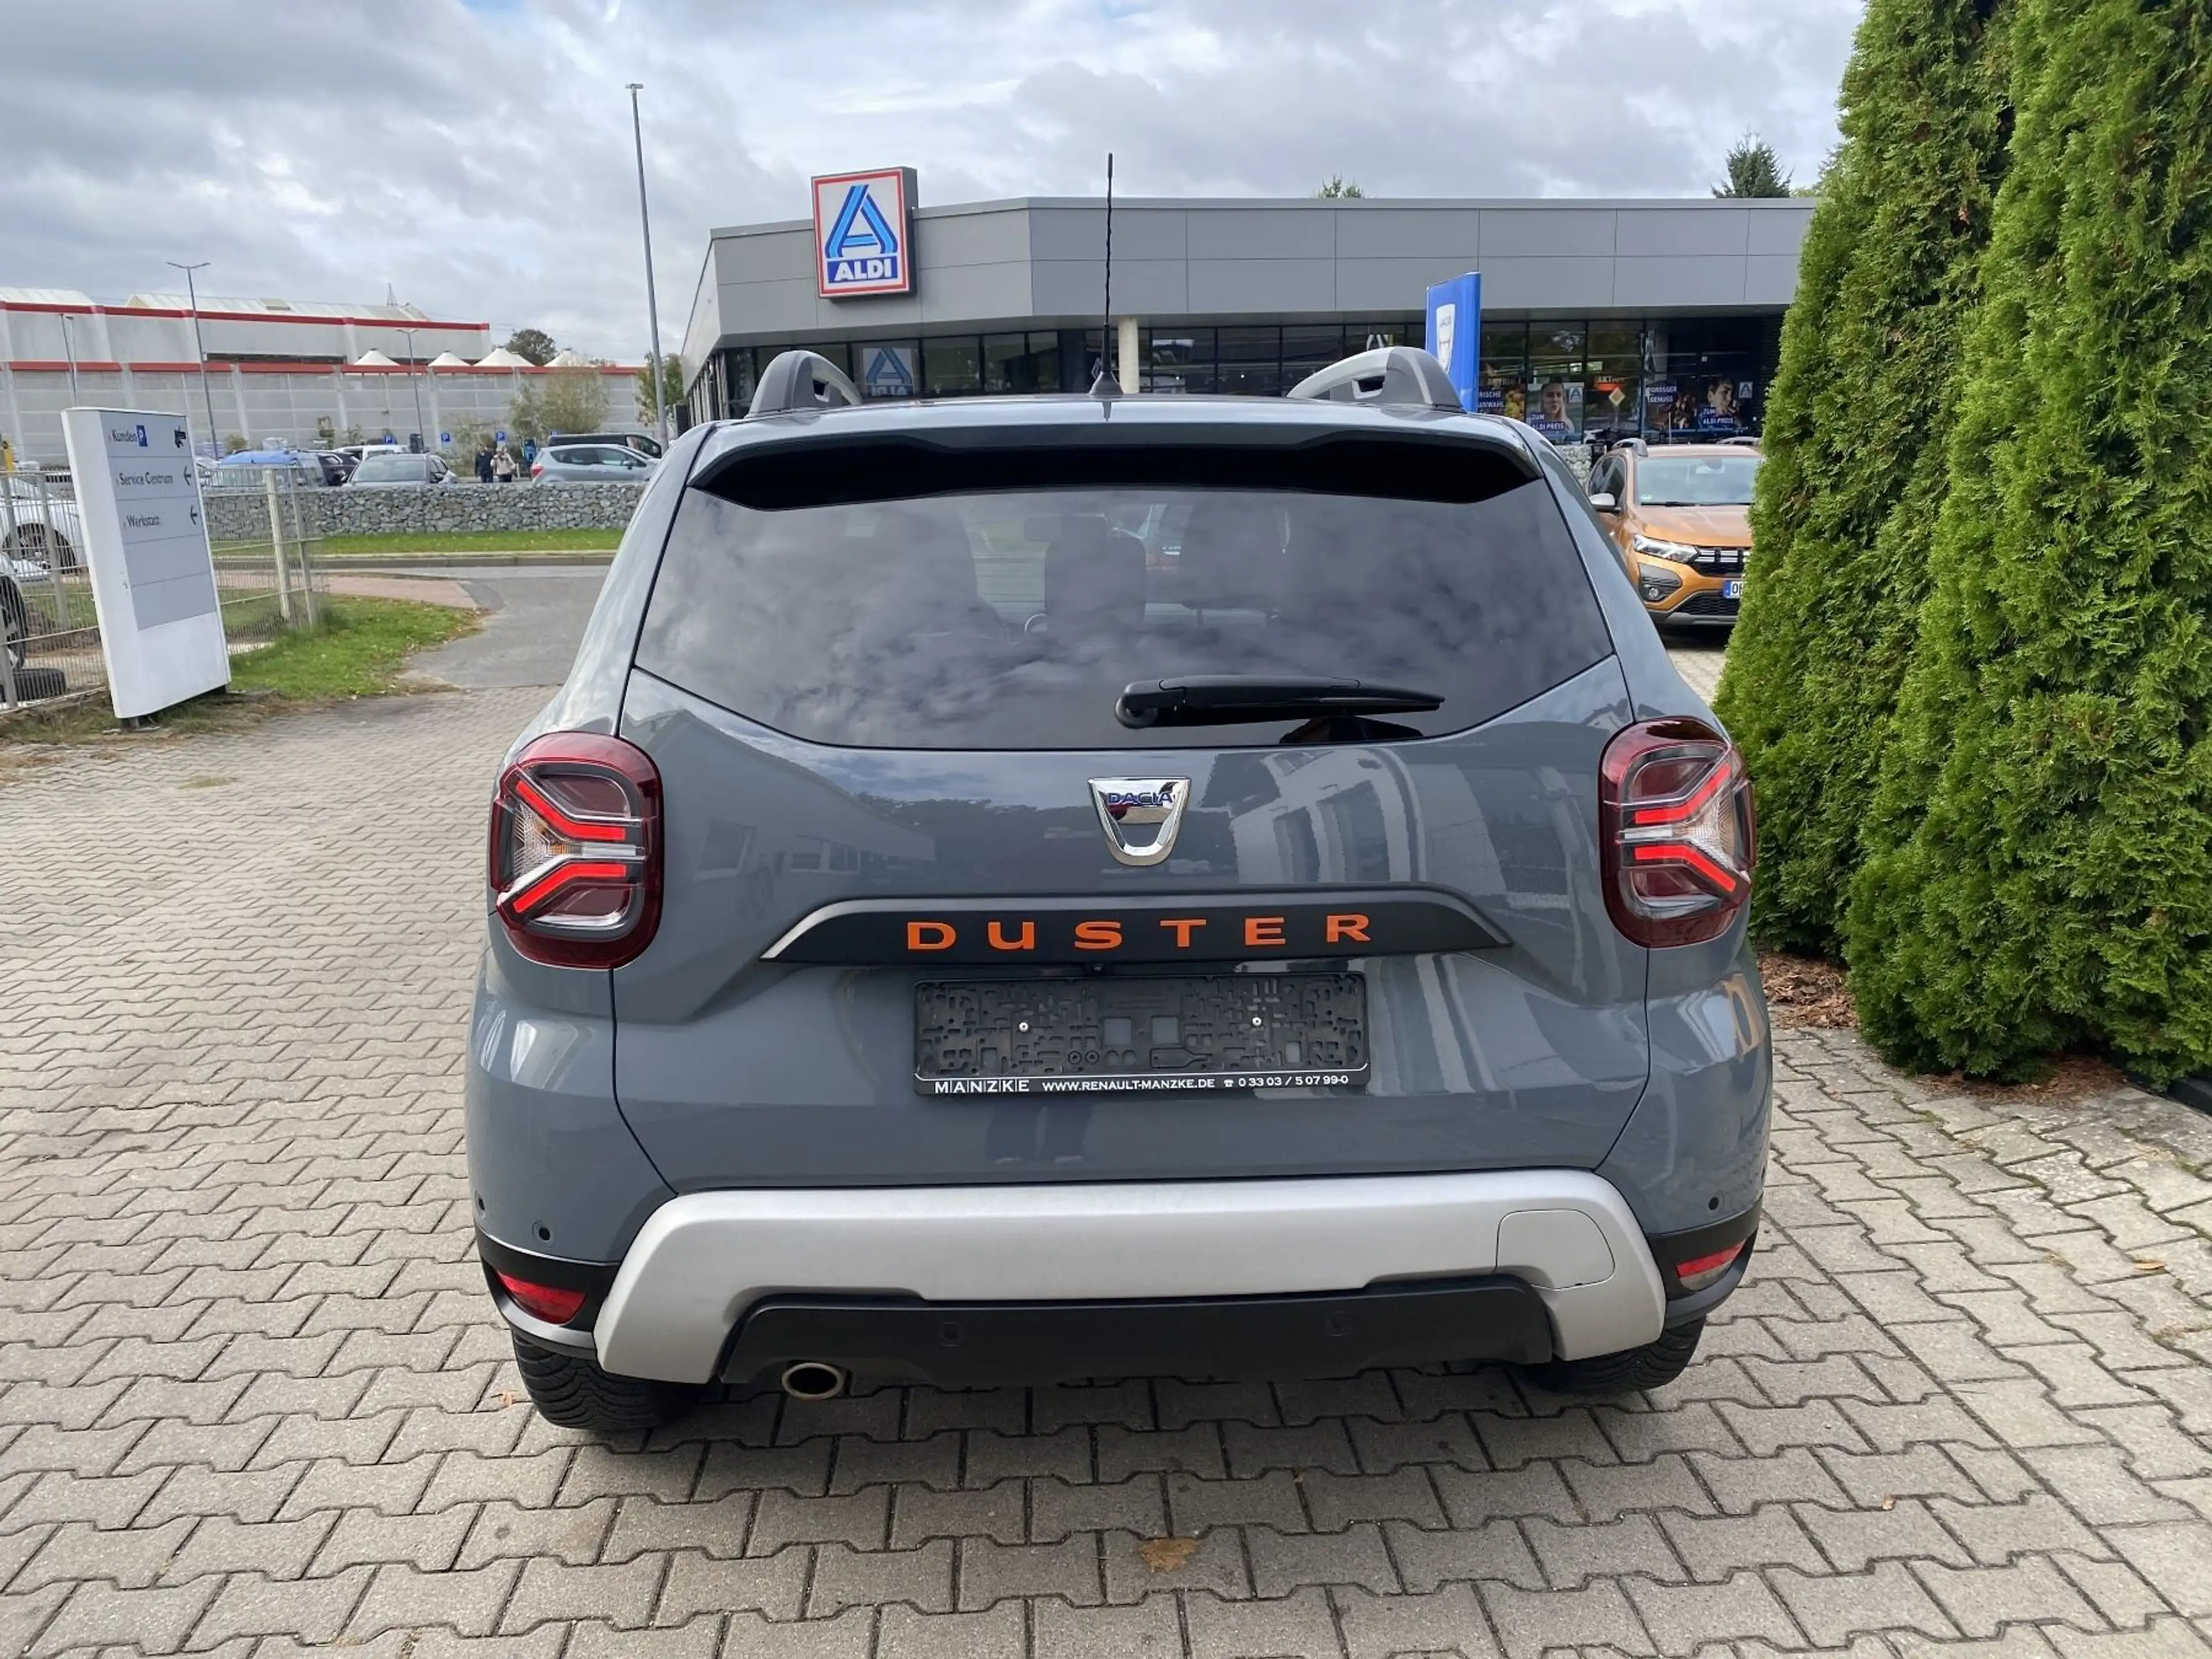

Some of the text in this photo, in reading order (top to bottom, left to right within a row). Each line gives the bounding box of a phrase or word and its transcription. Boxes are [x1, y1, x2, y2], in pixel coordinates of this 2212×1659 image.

[834, 258, 892, 281] ALDI
[119, 473, 144, 486] Service
[1108, 793, 1173, 804] DACIA
[907, 915, 1371, 950] DUSTER
[935, 1080, 1029, 1093] MANZKE
[1042, 1079, 1215, 1091] WWW.RENAULT-MANZKE.DE
